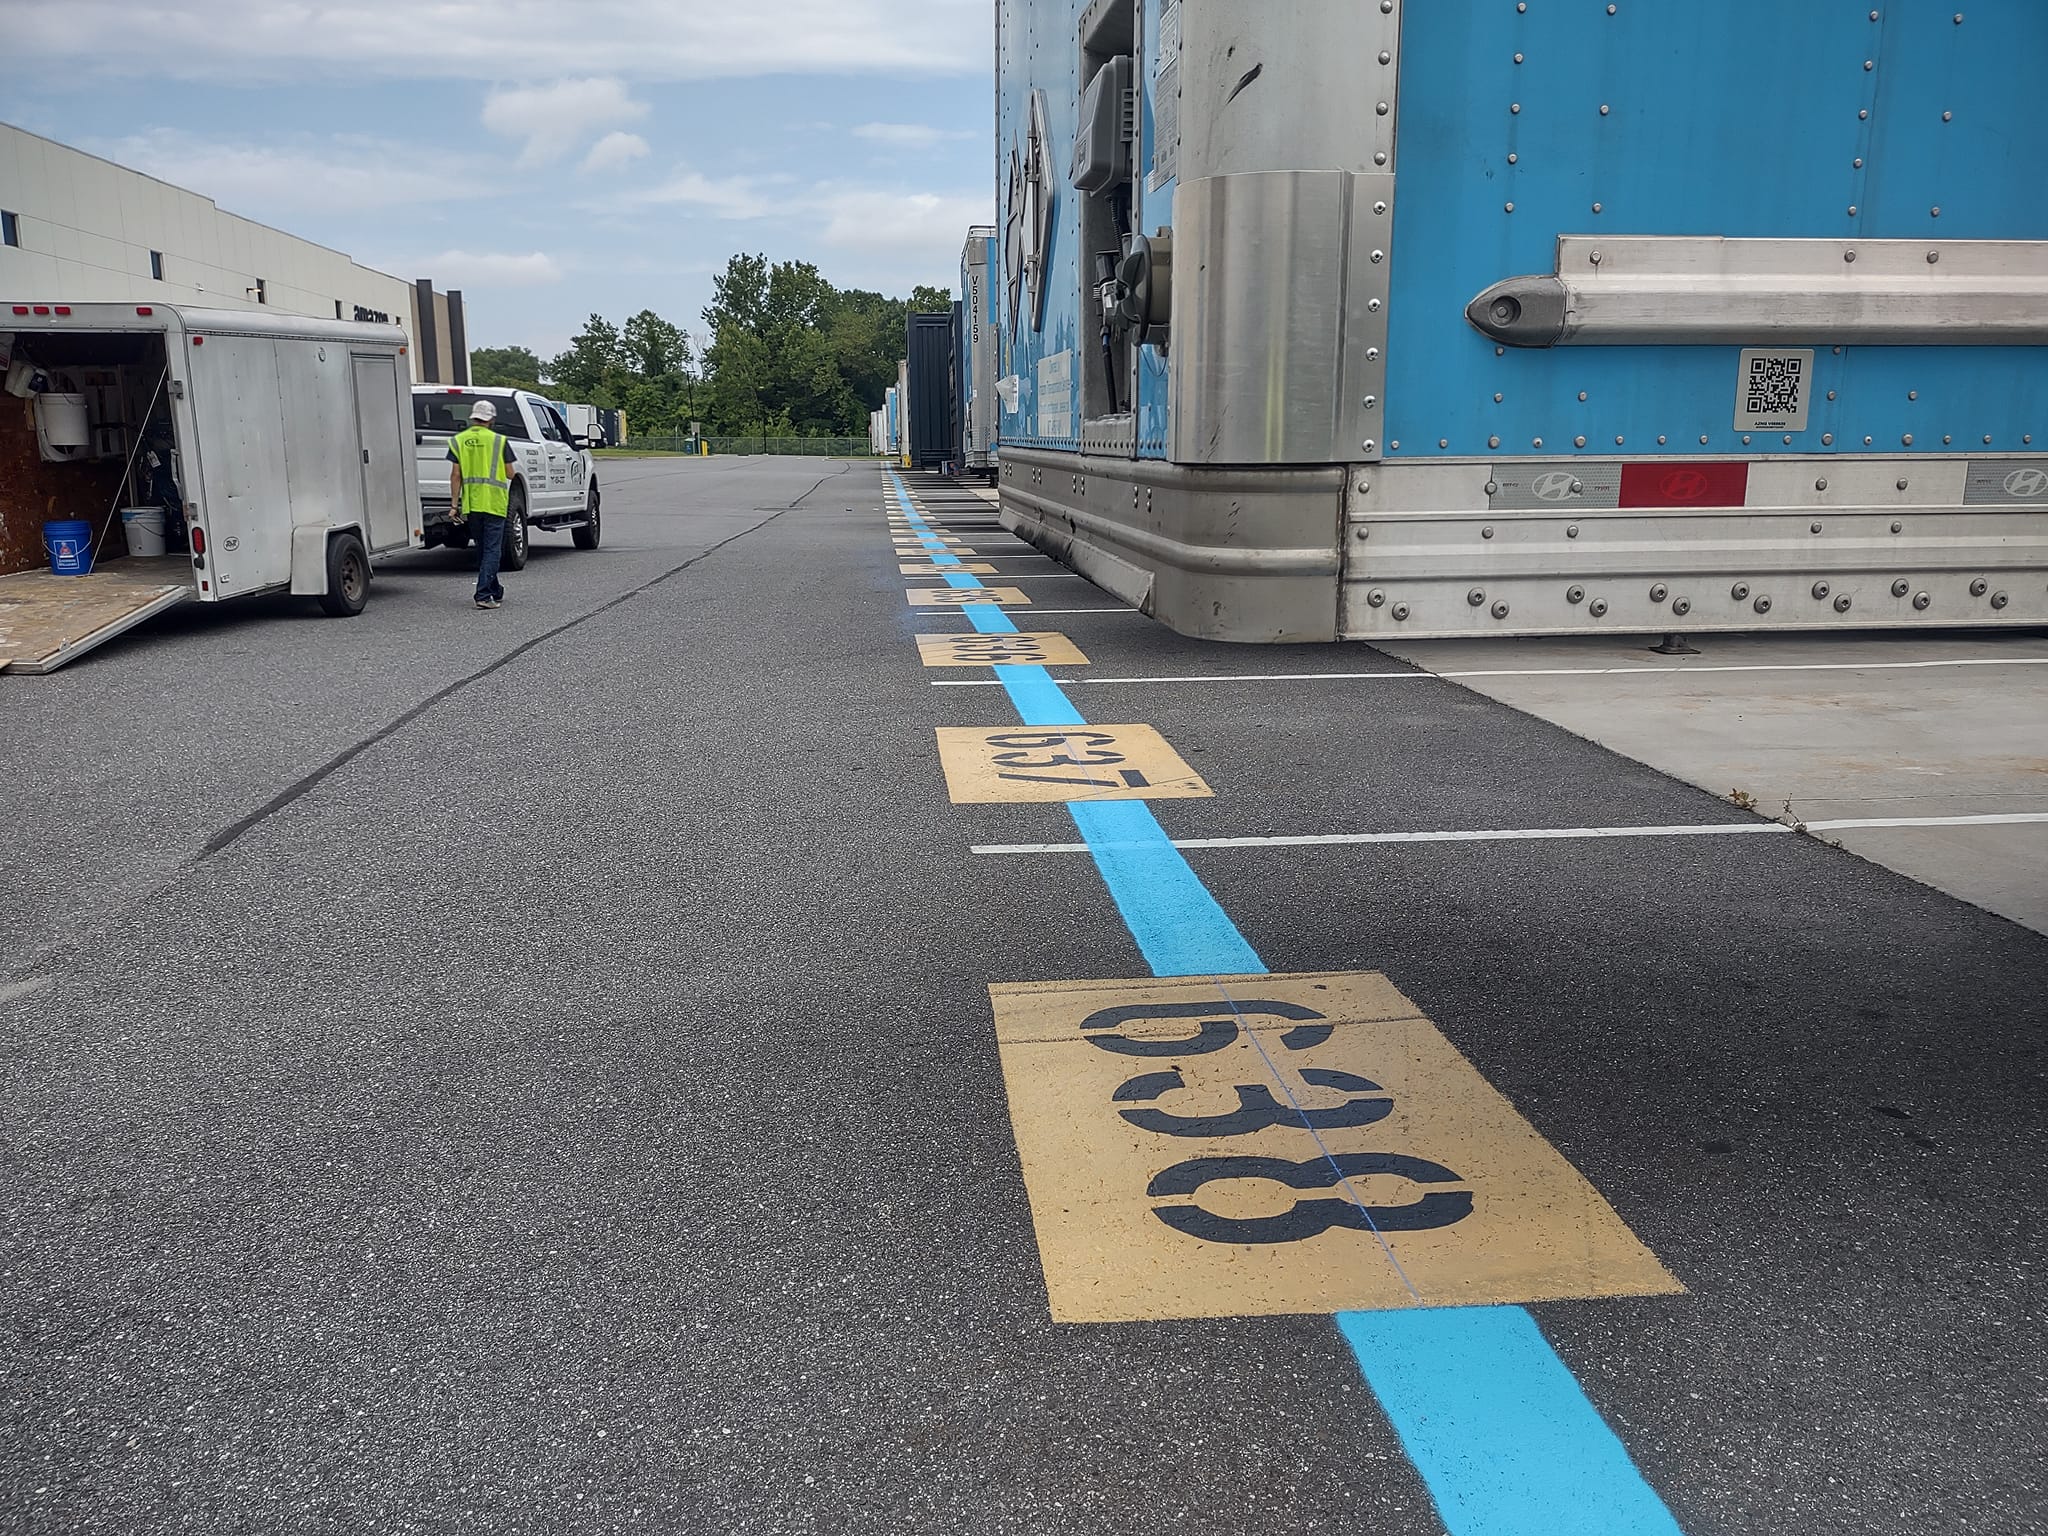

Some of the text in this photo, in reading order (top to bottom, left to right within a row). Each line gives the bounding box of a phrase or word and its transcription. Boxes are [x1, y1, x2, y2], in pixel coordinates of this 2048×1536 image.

[971, 275, 979, 343] V504159
[948, 636, 1048, 661] 636
[985, 731, 1151, 788] 637
[1079, 999, 1474, 1245] 638
